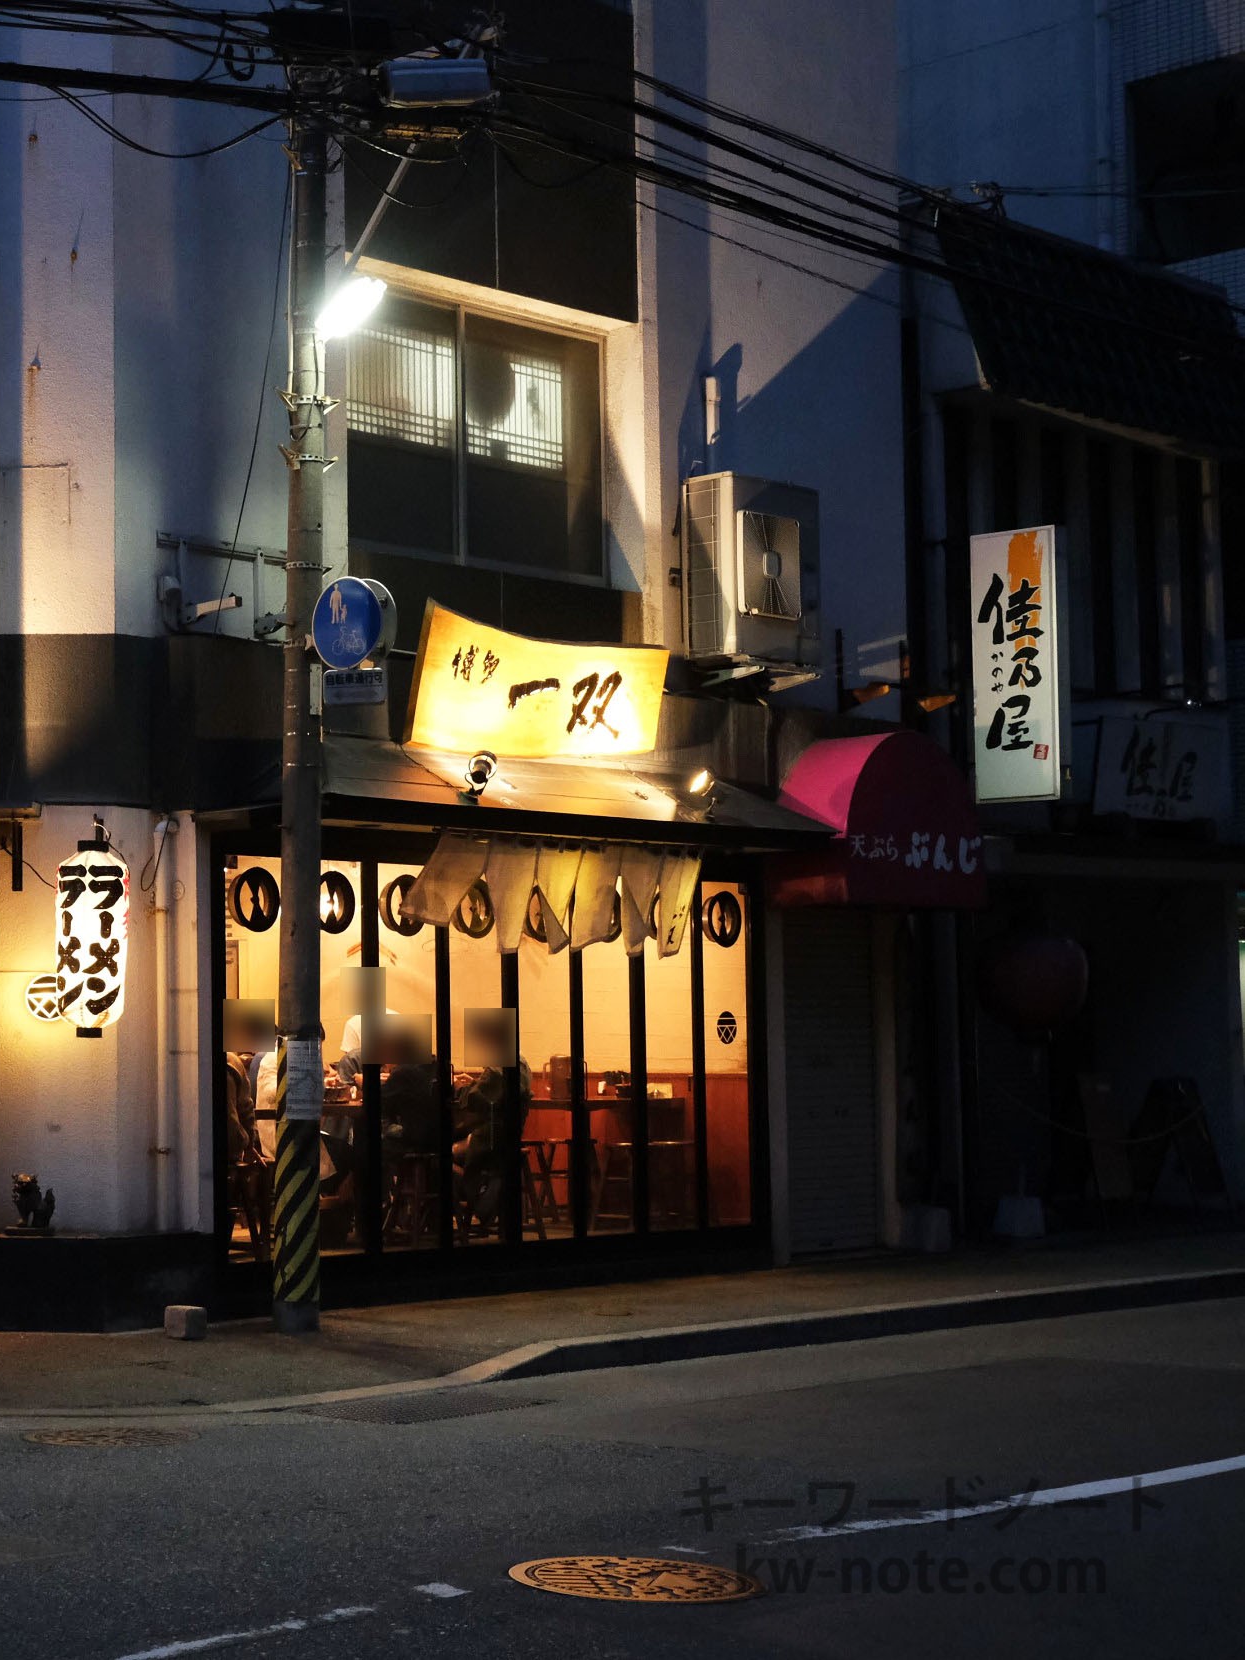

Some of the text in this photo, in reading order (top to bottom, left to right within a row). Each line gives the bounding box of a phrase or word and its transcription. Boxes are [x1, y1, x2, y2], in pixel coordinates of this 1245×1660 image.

[326, 672, 382, 686] 自転車通行可
[452, 644, 500, 684] 博多
[977, 573, 1044, 750] 佳乃屋
[991, 651, 1004, 693] かのや
[509, 671, 622, 739] 一双
[851, 831, 981, 874] 天ぷら ぶんじ
[57, 864, 87, 1014] ラーメン
[82, 864, 124, 1015] ラーメン
